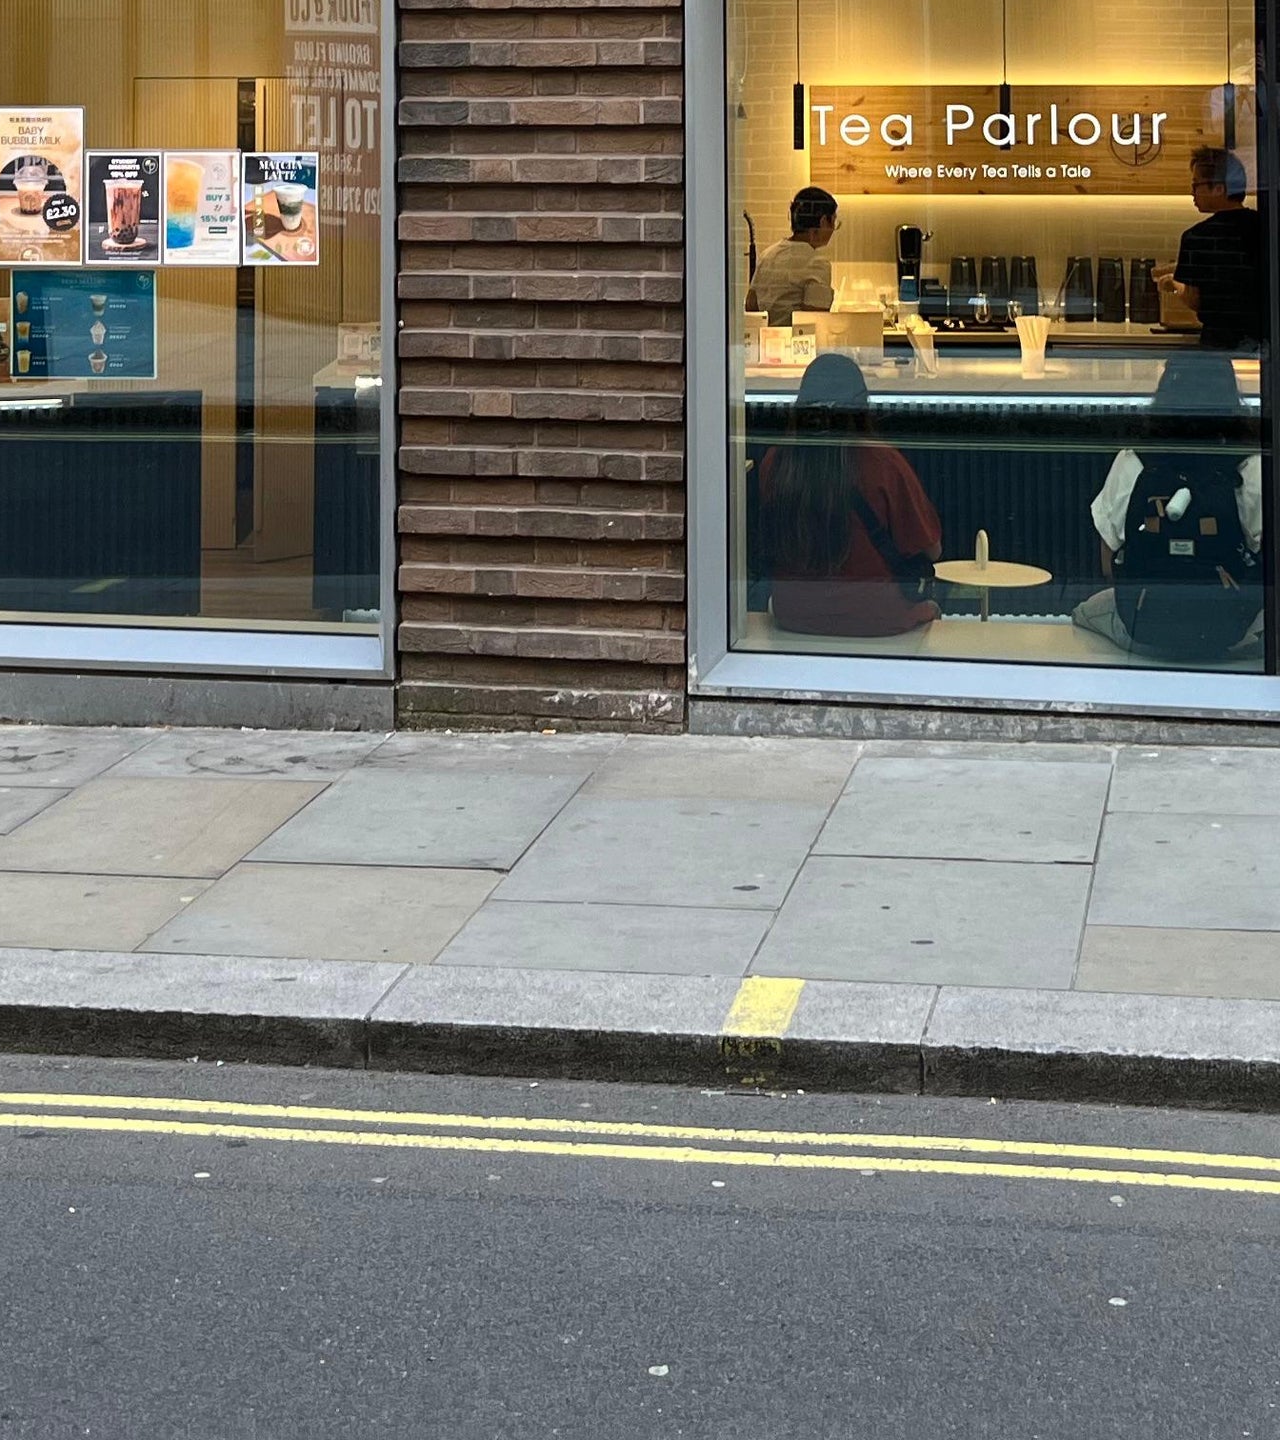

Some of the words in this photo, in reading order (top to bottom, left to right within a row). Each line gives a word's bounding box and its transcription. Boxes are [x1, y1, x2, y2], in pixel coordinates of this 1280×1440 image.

[811, 104, 913, 146] Tea
[946, 103, 1168, 146] Parlour
[18, 125, 43, 135] BABY
[0, 136, 38, 145] BUBBLE
[39, 136, 61, 145] MILK
[259, 160, 303, 170] MATCHA
[264, 170, 297, 181] LATTE
[885, 163, 933, 179] Where
[937, 163, 977, 181] Every
[981, 163, 1007, 179] Tea
[1012, 163, 1042, 179] Tells
[1045, 167, 1057, 179] a
[1060, 163, 1092, 179] Tale
[205, 193, 223, 202] BUY
[46, 204, 77, 220] £2.30
[219, 215, 236, 223] OFF
